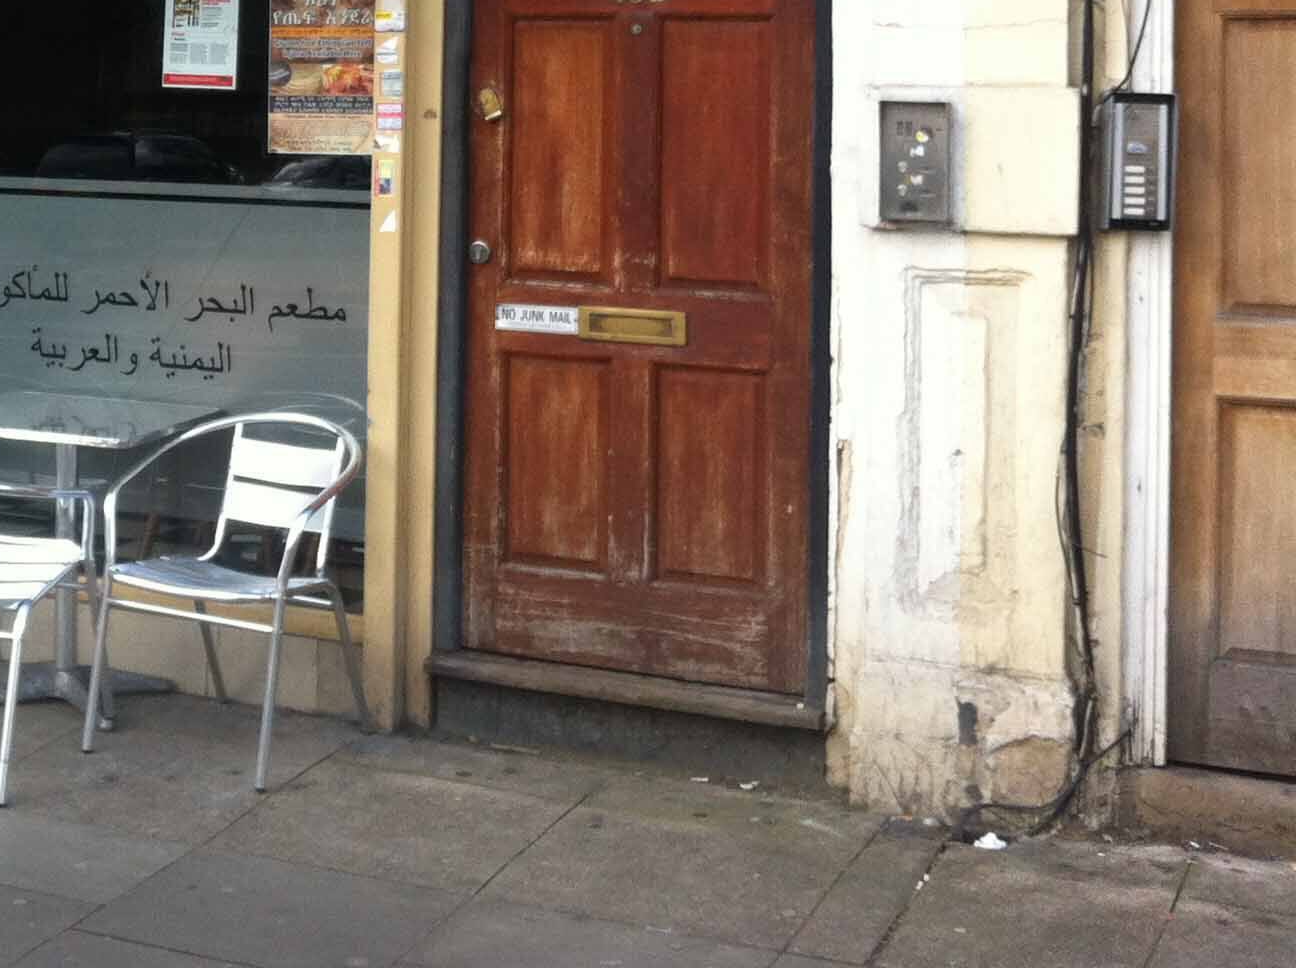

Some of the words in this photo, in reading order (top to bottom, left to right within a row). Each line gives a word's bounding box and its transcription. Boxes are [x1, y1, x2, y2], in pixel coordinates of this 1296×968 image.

[183, 284, 255, 322] البحر
[266, 287, 347, 331] مطعم
[502, 308, 515, 321] NO
[520, 310, 545, 323] JUNK
[549, 311, 571, 324] MAIL
[149, 337, 233, 380] اليمنية
